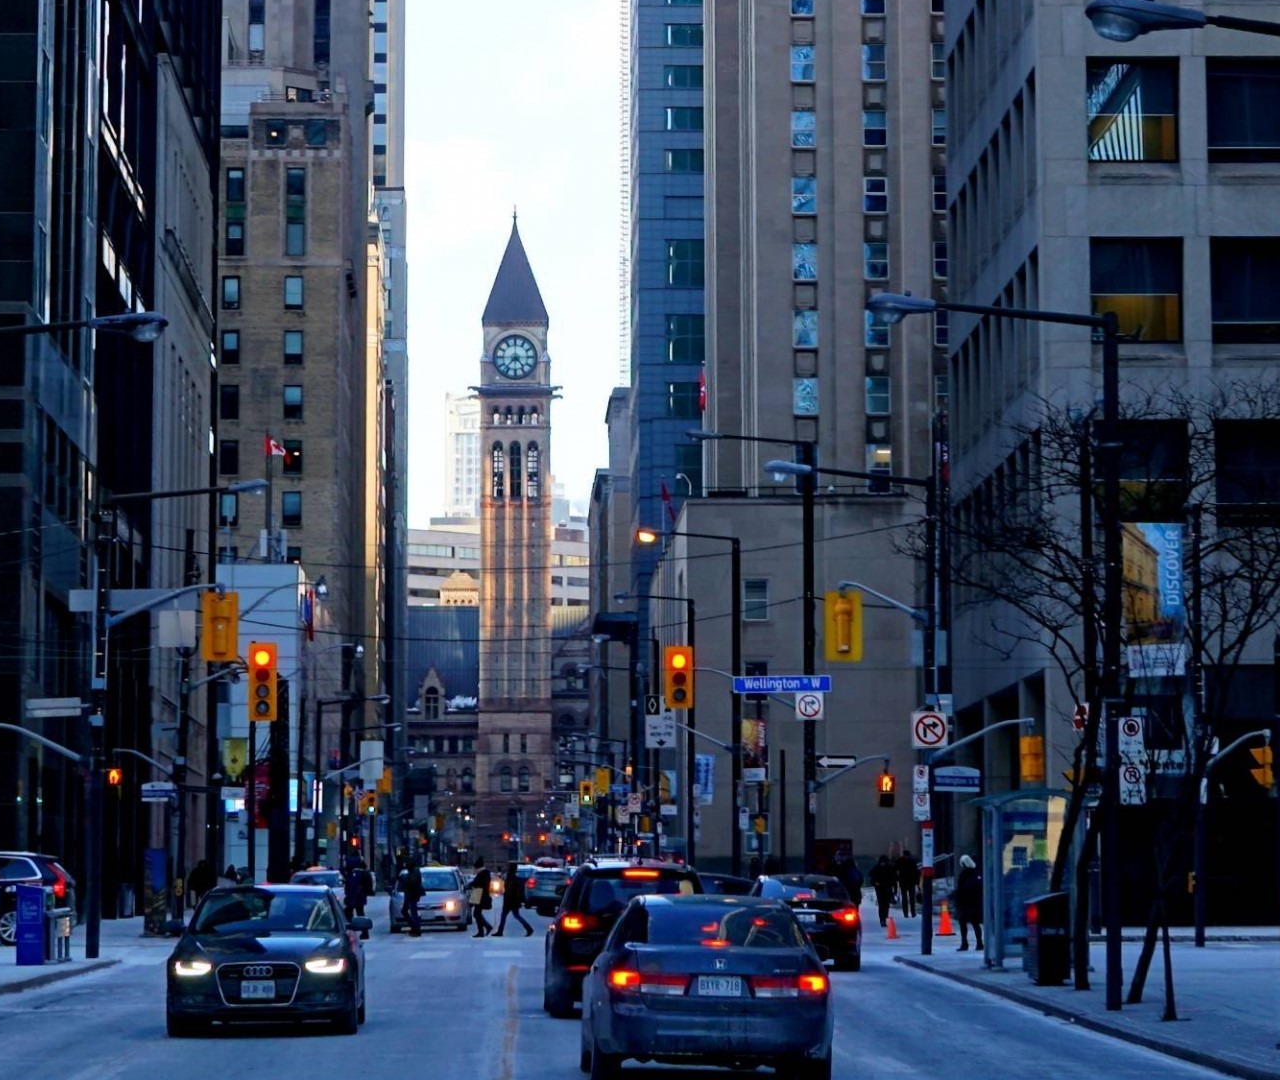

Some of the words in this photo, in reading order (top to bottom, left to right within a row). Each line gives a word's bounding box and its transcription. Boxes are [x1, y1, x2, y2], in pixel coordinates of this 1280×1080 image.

[1166, 530, 1180, 605] DISCOVER
[744, 678, 800, 691] Wellington
[811, 677, 821, 688] W
